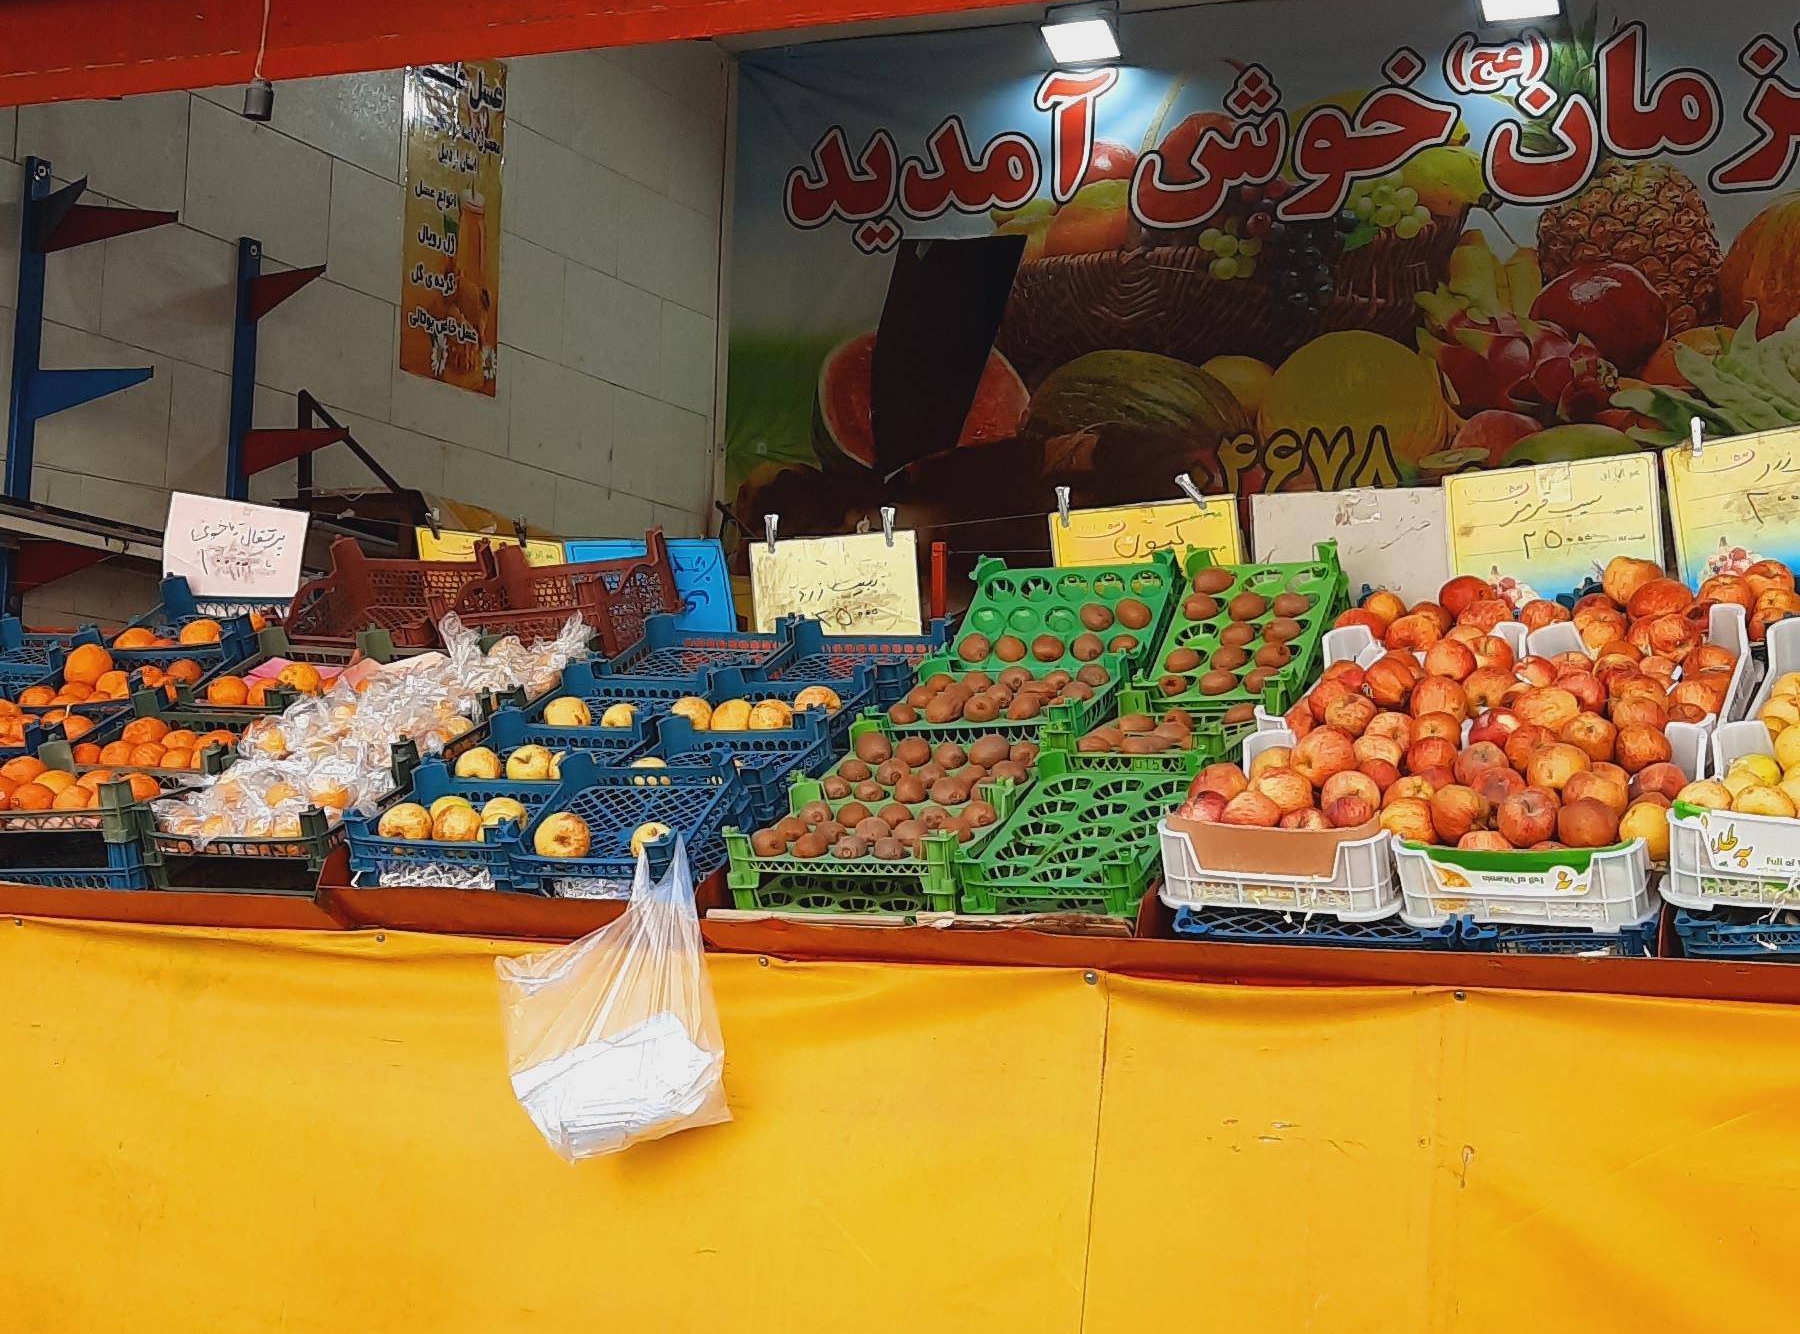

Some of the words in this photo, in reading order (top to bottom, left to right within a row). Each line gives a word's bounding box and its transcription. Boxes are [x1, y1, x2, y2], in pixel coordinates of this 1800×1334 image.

[1130, 51, 1460, 229] خوش
[1444, 30, 1552, 95] (عج)
[1474, 21, 1800, 207] زمان
[785, 67, 1118, 254] آمدید
[1216, 424, 1403, 493] ۴۶۷۸
